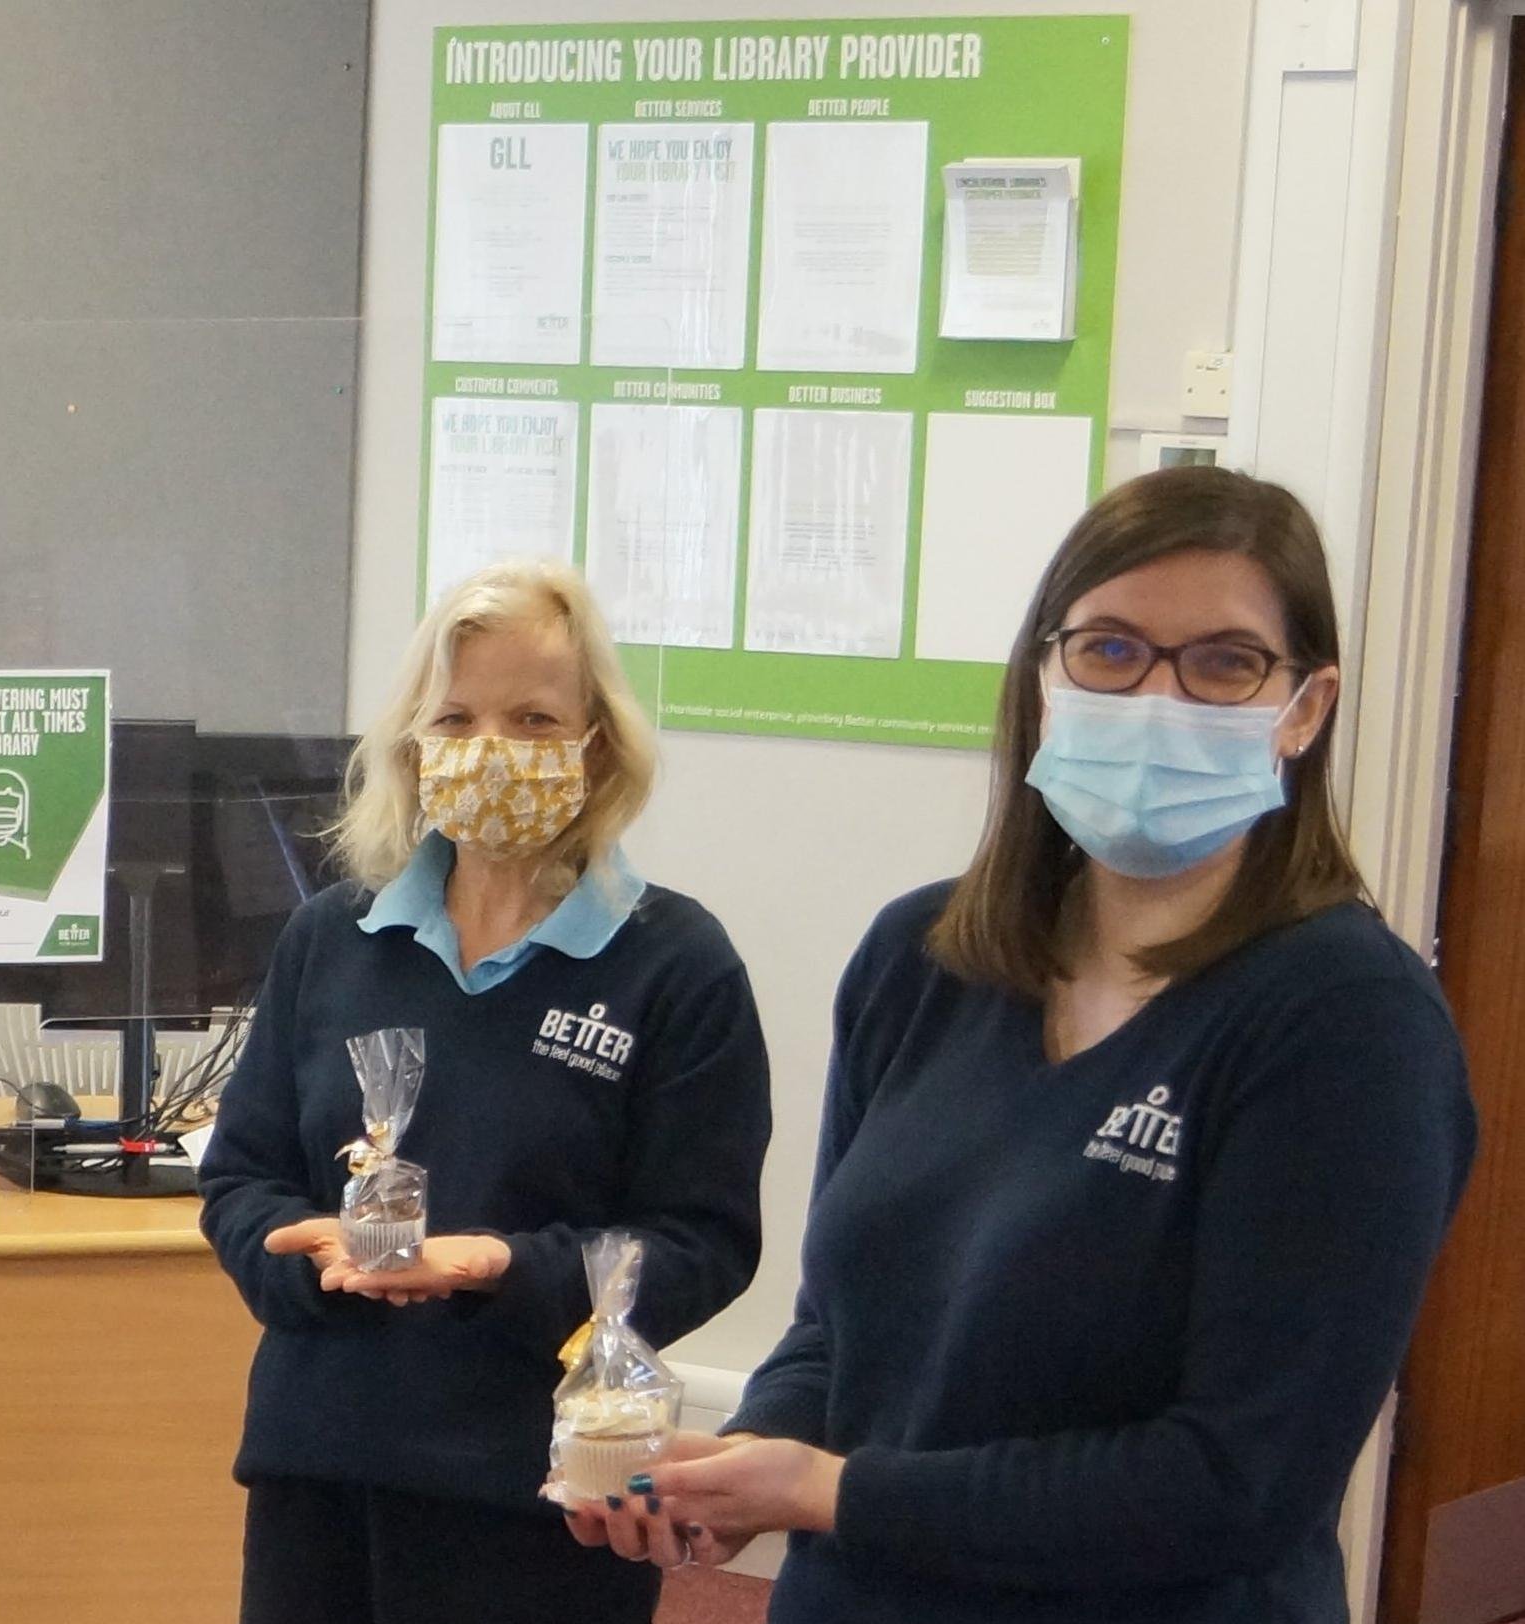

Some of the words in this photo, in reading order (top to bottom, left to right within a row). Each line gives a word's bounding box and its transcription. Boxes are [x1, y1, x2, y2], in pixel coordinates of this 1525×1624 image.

[446, 37, 622, 84] INTRODUCING
[633, 37, 703, 82] YOUR
[713, 35, 830, 81] LIBRARY
[840, 32, 982, 79] PROVIDER
[524, 102, 541, 118] GLL
[635, 100, 672, 118] BETTER
[675, 100, 722, 117] SERVICES
[808, 99, 847, 116] BETTER
[851, 98, 890, 116] PEOPLE
[490, 137, 532, 170] GLL
[608, 141, 627, 160] WE
[630, 140, 660, 160] HOPE
[665, 140, 689, 160] YOU
[694, 139, 734, 160] ENJOY
[455, 376, 505, 394] CUSTOMER
[507, 378, 559, 395] COMMENTS
[613, 380, 651, 398] BETTER
[653, 381, 722, 400] COMMUNITIES
[788, 386, 827, 403] BETTER
[831, 387, 882, 404] BUSINESS
[965, 389, 1031, 409] SUGGESTION
[1034, 392, 1056, 410] BOX
[49, 687, 90, 710] MUST
[12, 711, 38, 732] ALL
[42, 711, 87, 733] TIMES
[538, 1007, 635, 1066] BETTER
